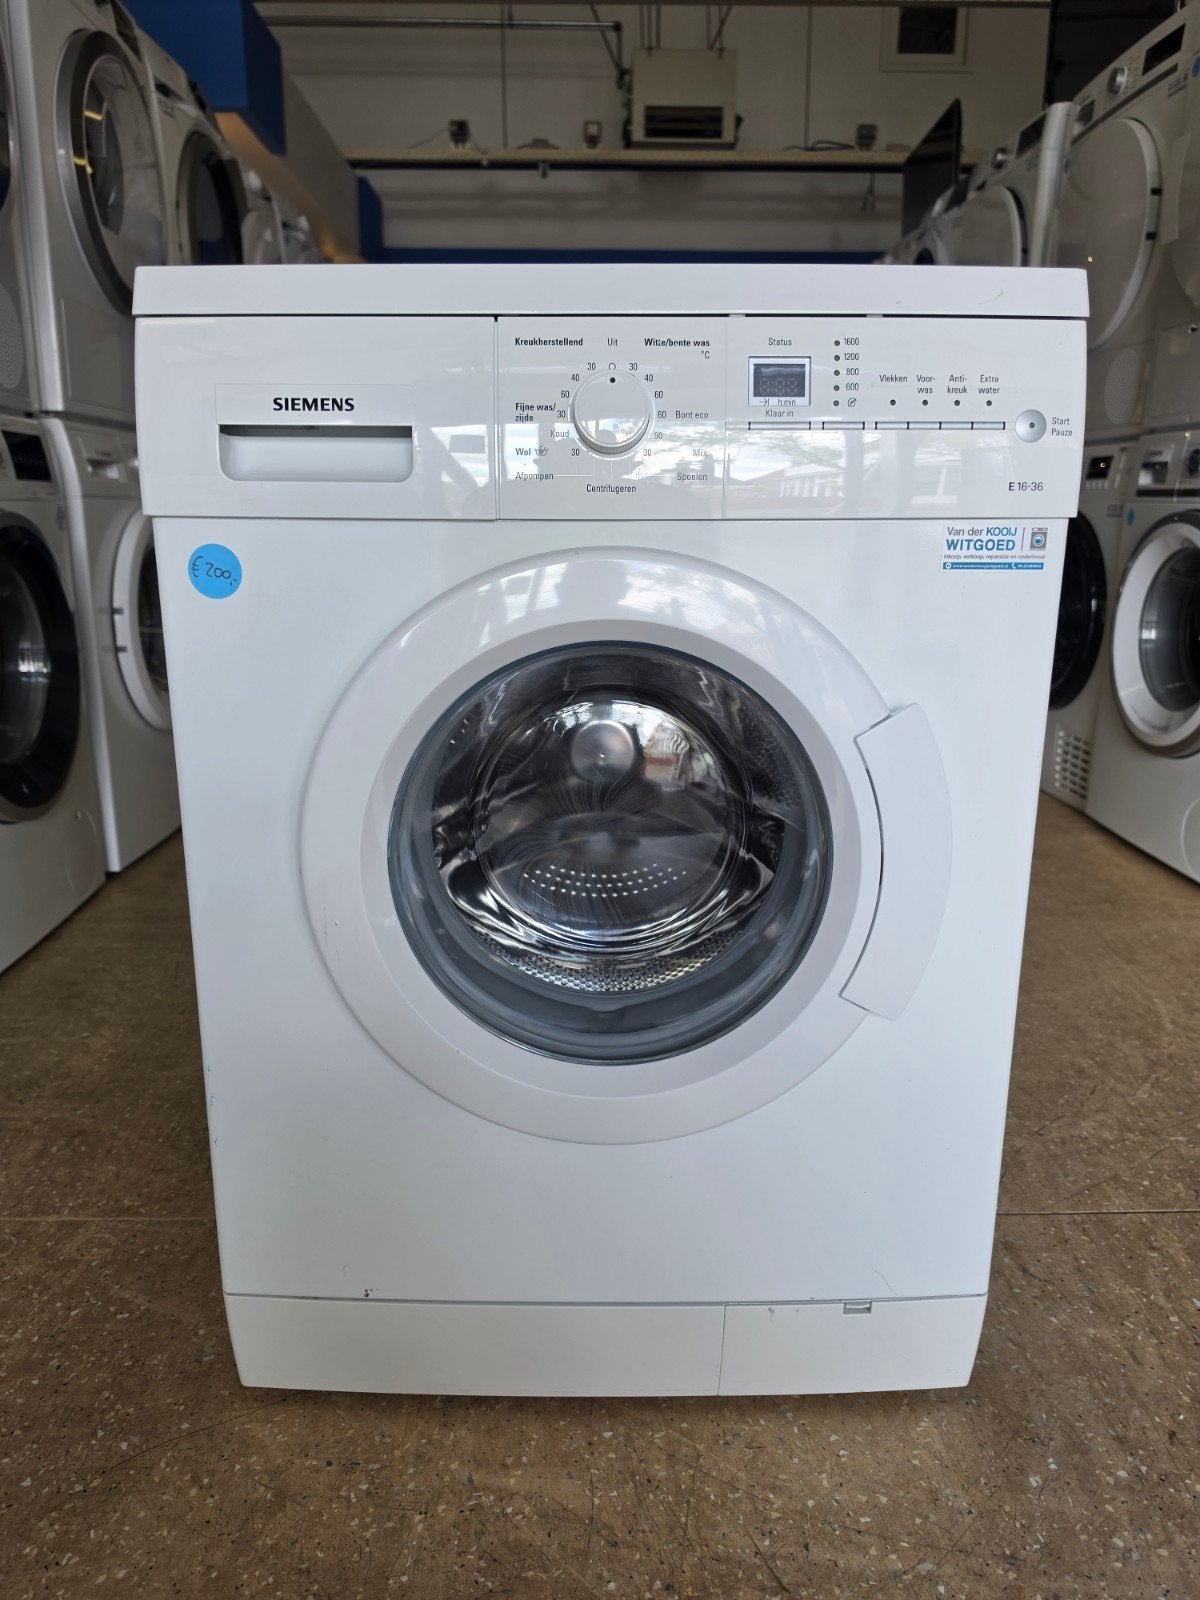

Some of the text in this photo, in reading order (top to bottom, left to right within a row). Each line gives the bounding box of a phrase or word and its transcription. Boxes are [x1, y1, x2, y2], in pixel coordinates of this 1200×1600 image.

[515, 337, 583, 346] Kreukherstellend
[644, 338, 691, 347] Witte/bonte
[768, 338, 792, 346] Status
[843, 337, 860, 346] 1600
[700, 350, 710, 359] °C
[843, 353, 860, 361] 1200
[846, 368, 860, 376] 800
[879, 374, 908, 383] Vlekken
[916, 375, 936, 383] Voor-
[949, 375, 968, 383] Anti-
[980, 375, 999, 383] Extra
[846, 383, 860, 391] 600
[947, 386, 968, 394] kreuk
[978, 386, 1000, 394] water
[273, 397, 355, 411] SIEMENS
[515, 403, 556, 412] Fijne was/
[515, 414, 534, 422] zijde
[1051, 417, 1070, 425] Start
[1051, 428, 1073, 437] Pauze
[515, 472, 554, 481] Afpompen
[677, 473, 707, 482] Spoelen
[586, 485, 637, 494] Centrifugeren
[1009, 482, 1015, 491] E
[947, 527, 1017, 536] Van der KOOIJ
[946, 539, 1015, 550] WITGOED
